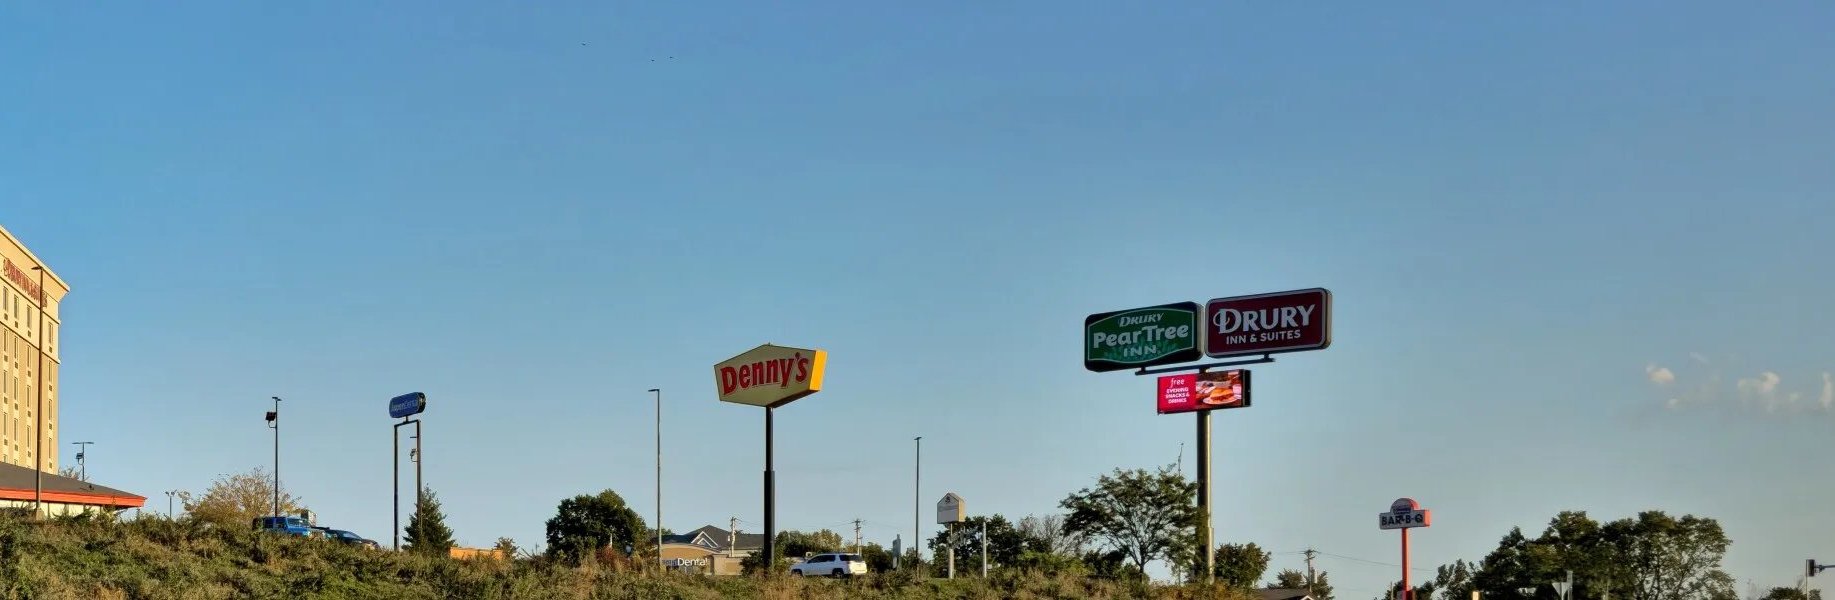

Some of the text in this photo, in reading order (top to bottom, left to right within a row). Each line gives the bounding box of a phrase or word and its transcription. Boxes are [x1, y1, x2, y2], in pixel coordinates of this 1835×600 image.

[1118, 313, 1165, 327] DRURY
[1212, 304, 1316, 334] DRURY
[1226, 329, 1301, 345] INN & SUITES
[1123, 344, 1157, 357] INN
[720, 352, 809, 395] Denny's
[1170, 378, 1185, 389] free
